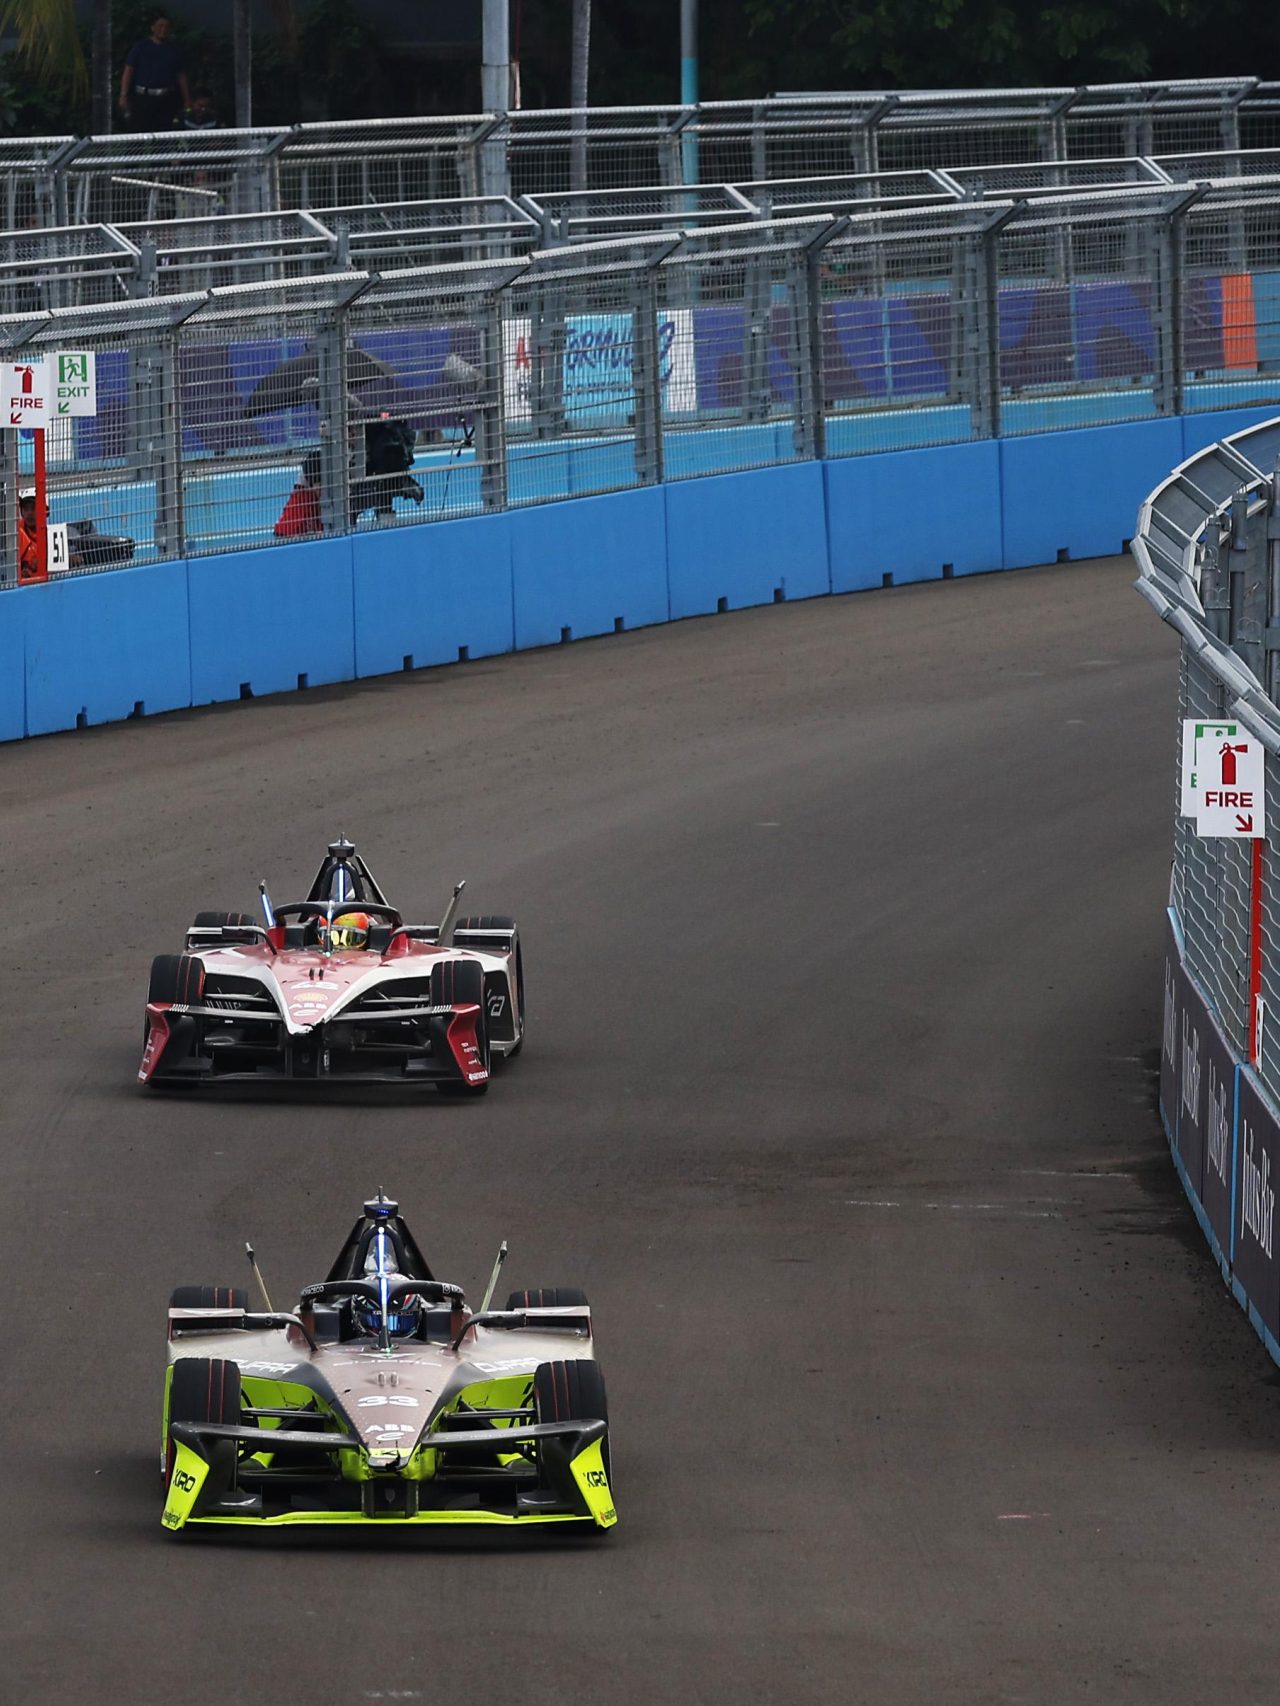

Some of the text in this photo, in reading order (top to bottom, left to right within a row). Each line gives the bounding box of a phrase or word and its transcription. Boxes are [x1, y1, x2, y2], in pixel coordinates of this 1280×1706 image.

[57, 386, 90, 398] EXIT
[10, 397, 44, 409] FIRE
[1205, 791, 1254, 808] FIRE
[231, 1358, 298, 1374] UPRA
[357, 1395, 420, 1407] 33
[365, 1423, 416, 1434] ABB
